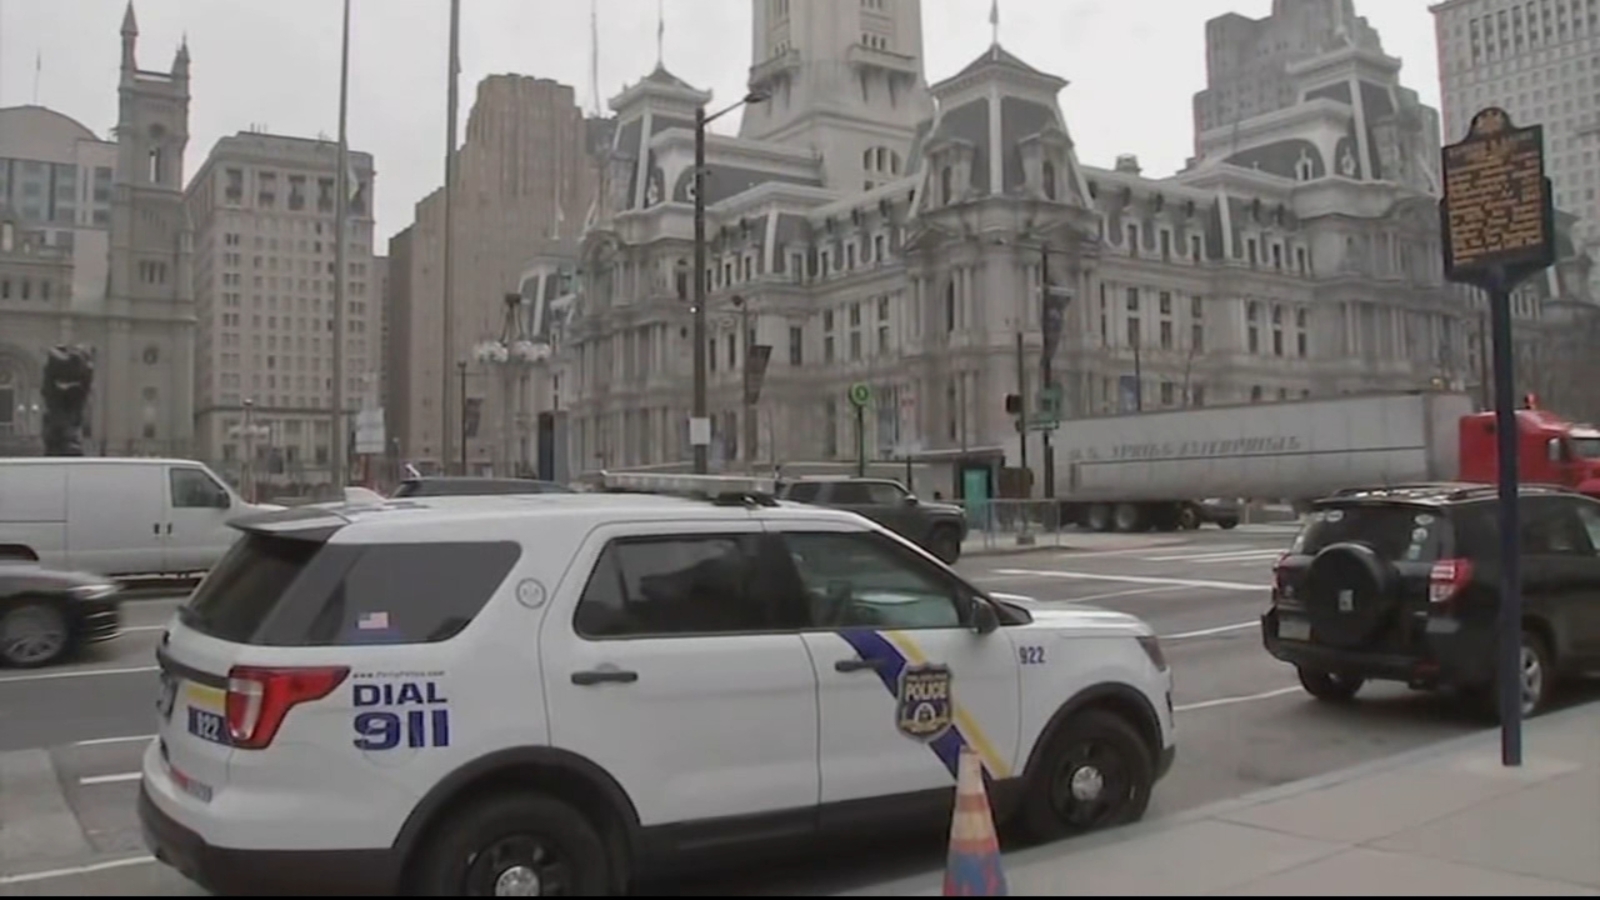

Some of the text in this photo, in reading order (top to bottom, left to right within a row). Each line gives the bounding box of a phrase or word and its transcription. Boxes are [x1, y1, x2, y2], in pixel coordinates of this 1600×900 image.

[1019, 646, 1046, 664] 922
[353, 682, 448, 707] DIAL
[905, 681, 948, 702] POLICE
[353, 709, 449, 751] 911
